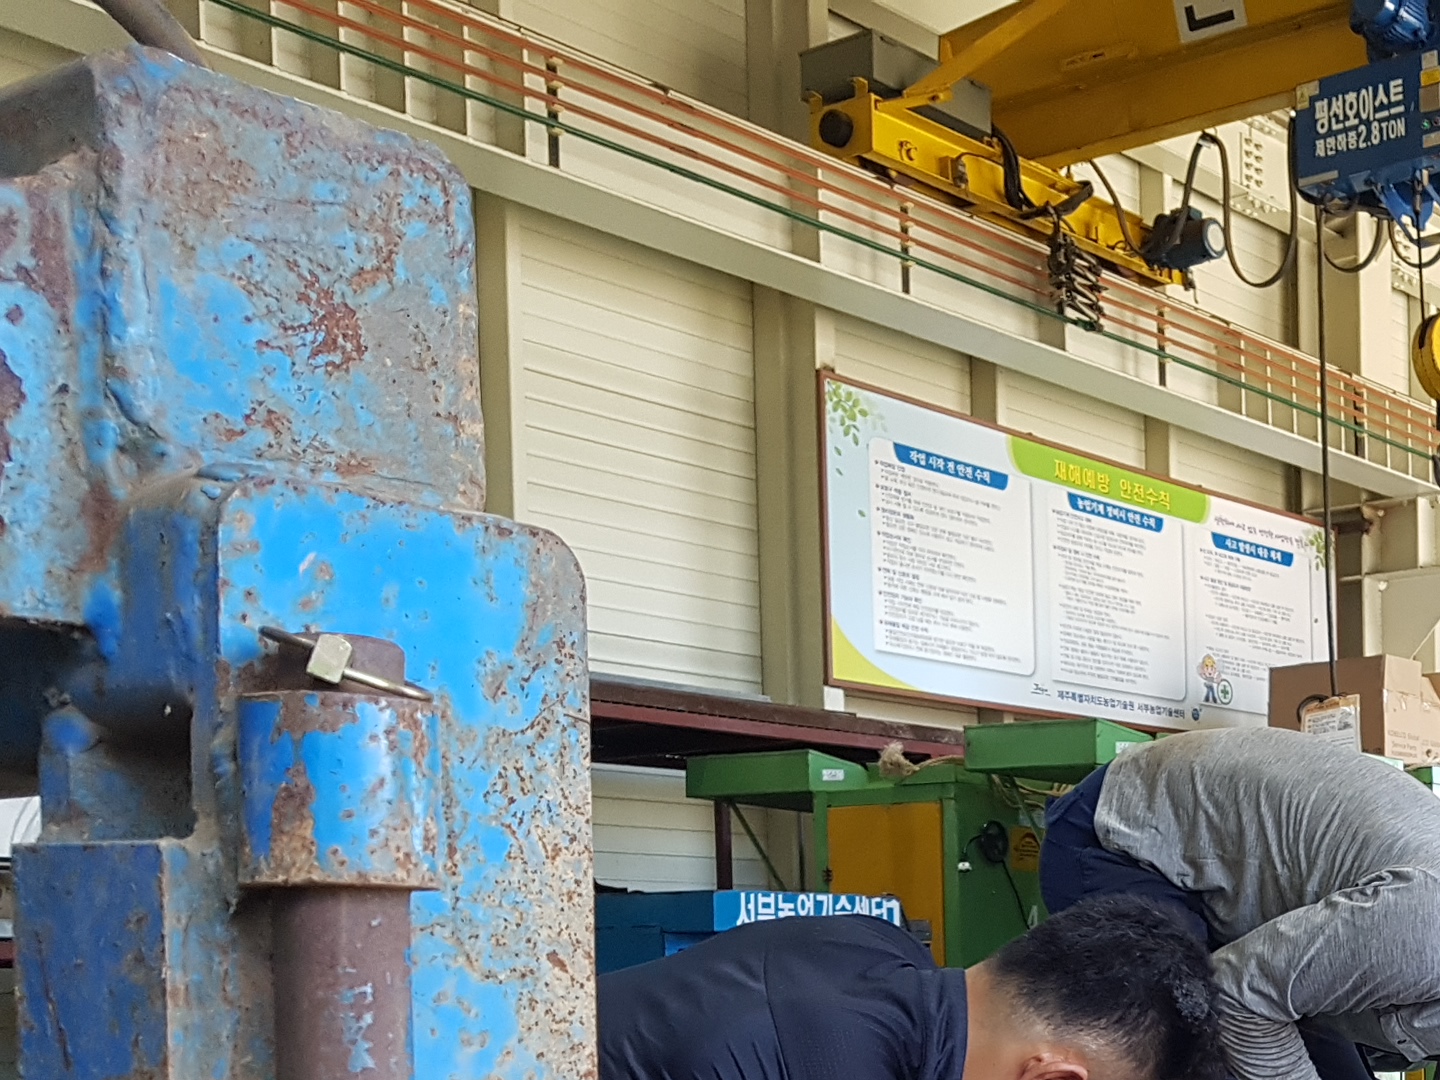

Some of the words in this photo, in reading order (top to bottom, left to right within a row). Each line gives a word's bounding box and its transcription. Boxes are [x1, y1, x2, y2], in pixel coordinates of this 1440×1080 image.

[1315, 78, 1405, 134] 평선호이스트
[909, 450, 926, 465] 작업
[928, 456, 945, 471] 시작
[957, 463, 973, 479] 안전
[974, 469, 991, 484] 수칙
[1054, 459, 1110, 494] 재해예방
[1120, 478, 1170, 510] 안전수칙
[1137, 704, 1185, 719] 서부농업기술센터
